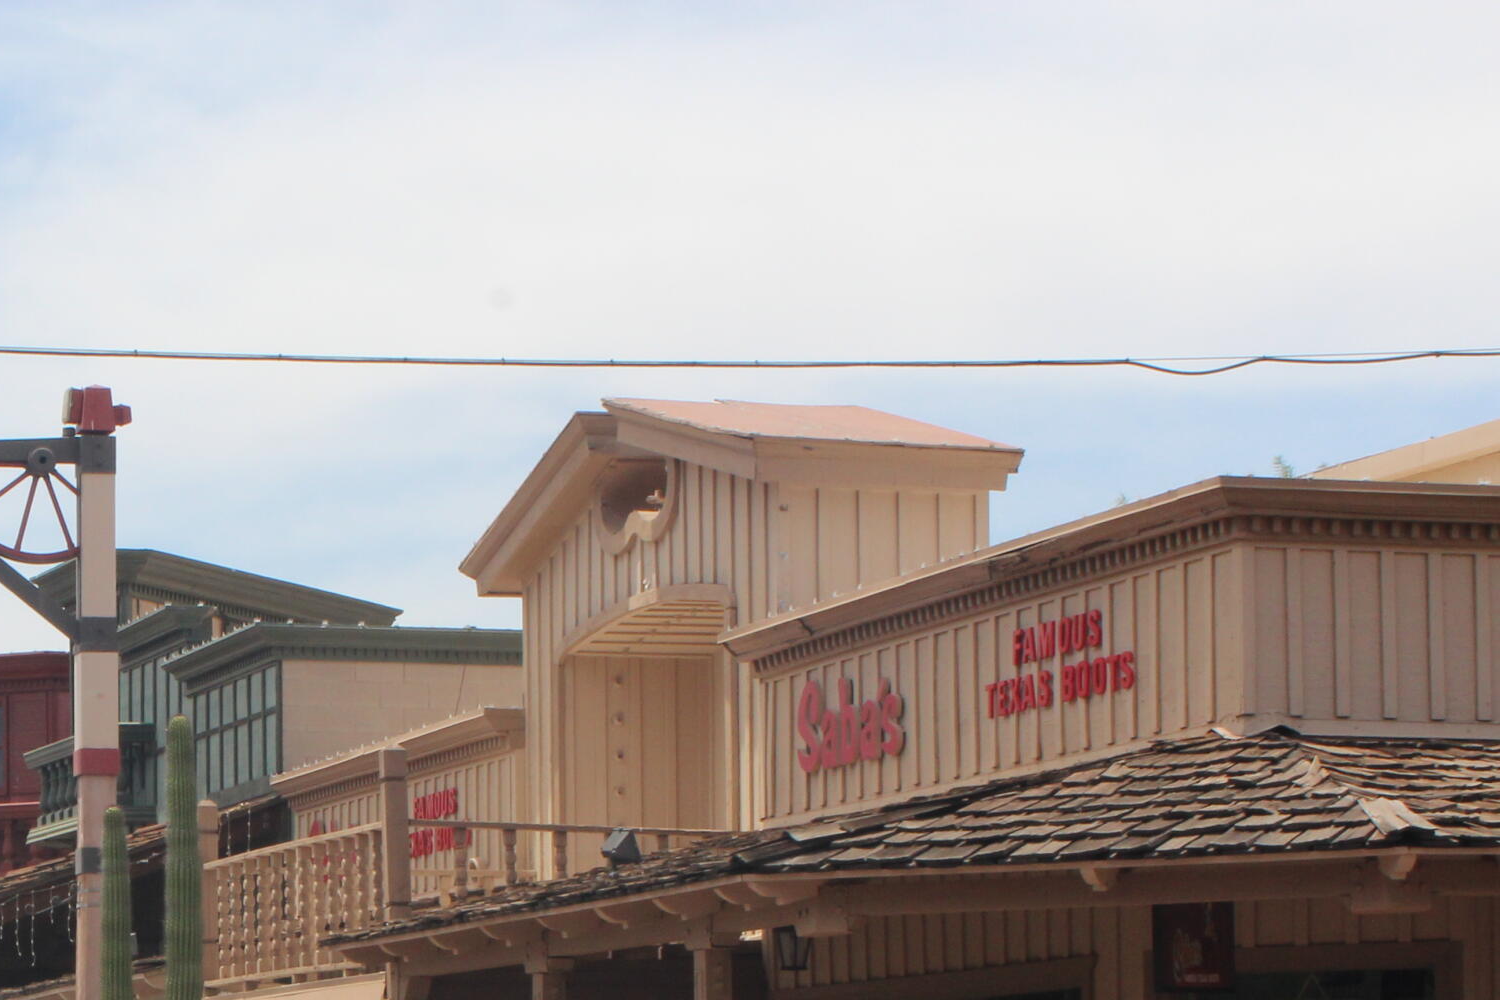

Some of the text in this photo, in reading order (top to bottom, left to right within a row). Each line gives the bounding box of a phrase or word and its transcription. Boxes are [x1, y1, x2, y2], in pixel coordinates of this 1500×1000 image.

[1012, 609, 1102, 666] FAMOUS
[985, 651, 1135, 719] TEXAS BOOTS
[797, 677, 905, 774] Saba's
[414, 788, 458, 820] FAMOUS
